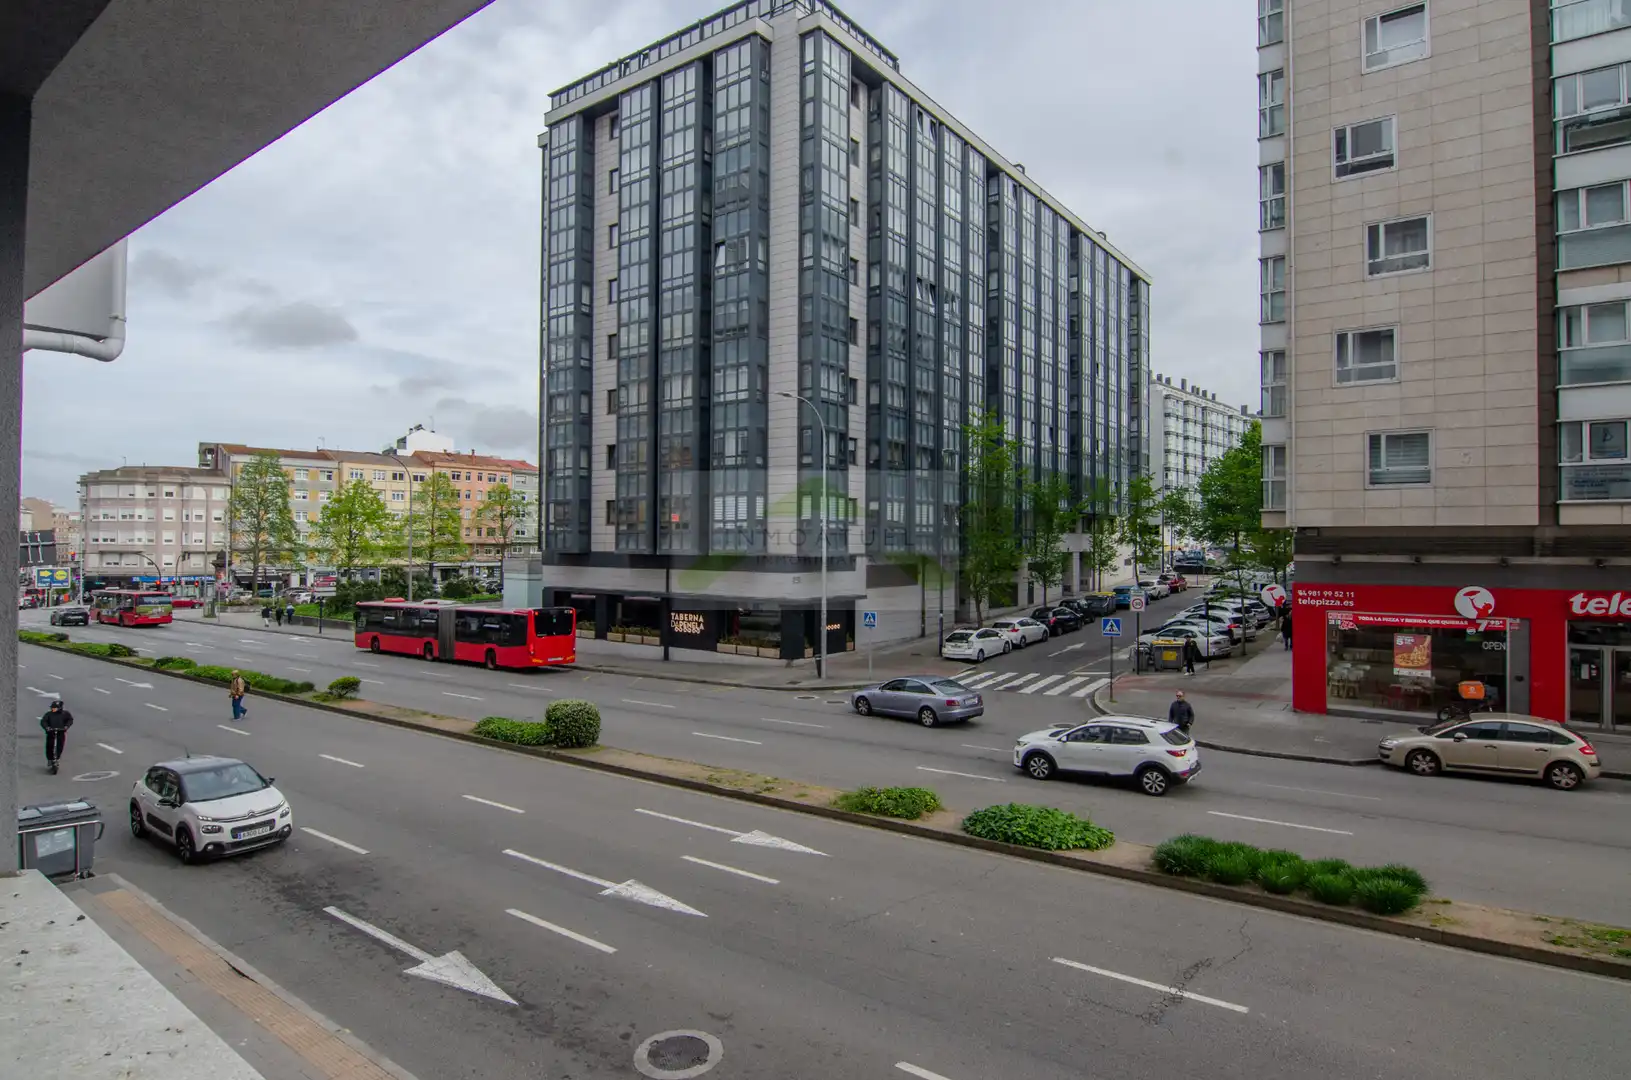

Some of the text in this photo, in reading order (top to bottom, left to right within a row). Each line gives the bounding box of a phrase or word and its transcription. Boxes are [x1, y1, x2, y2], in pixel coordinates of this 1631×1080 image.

[1298, 597, 1354, 607] telepizza.es
[670, 612, 704, 623] TABERNA
[1482, 641, 1506, 651] OPEN
